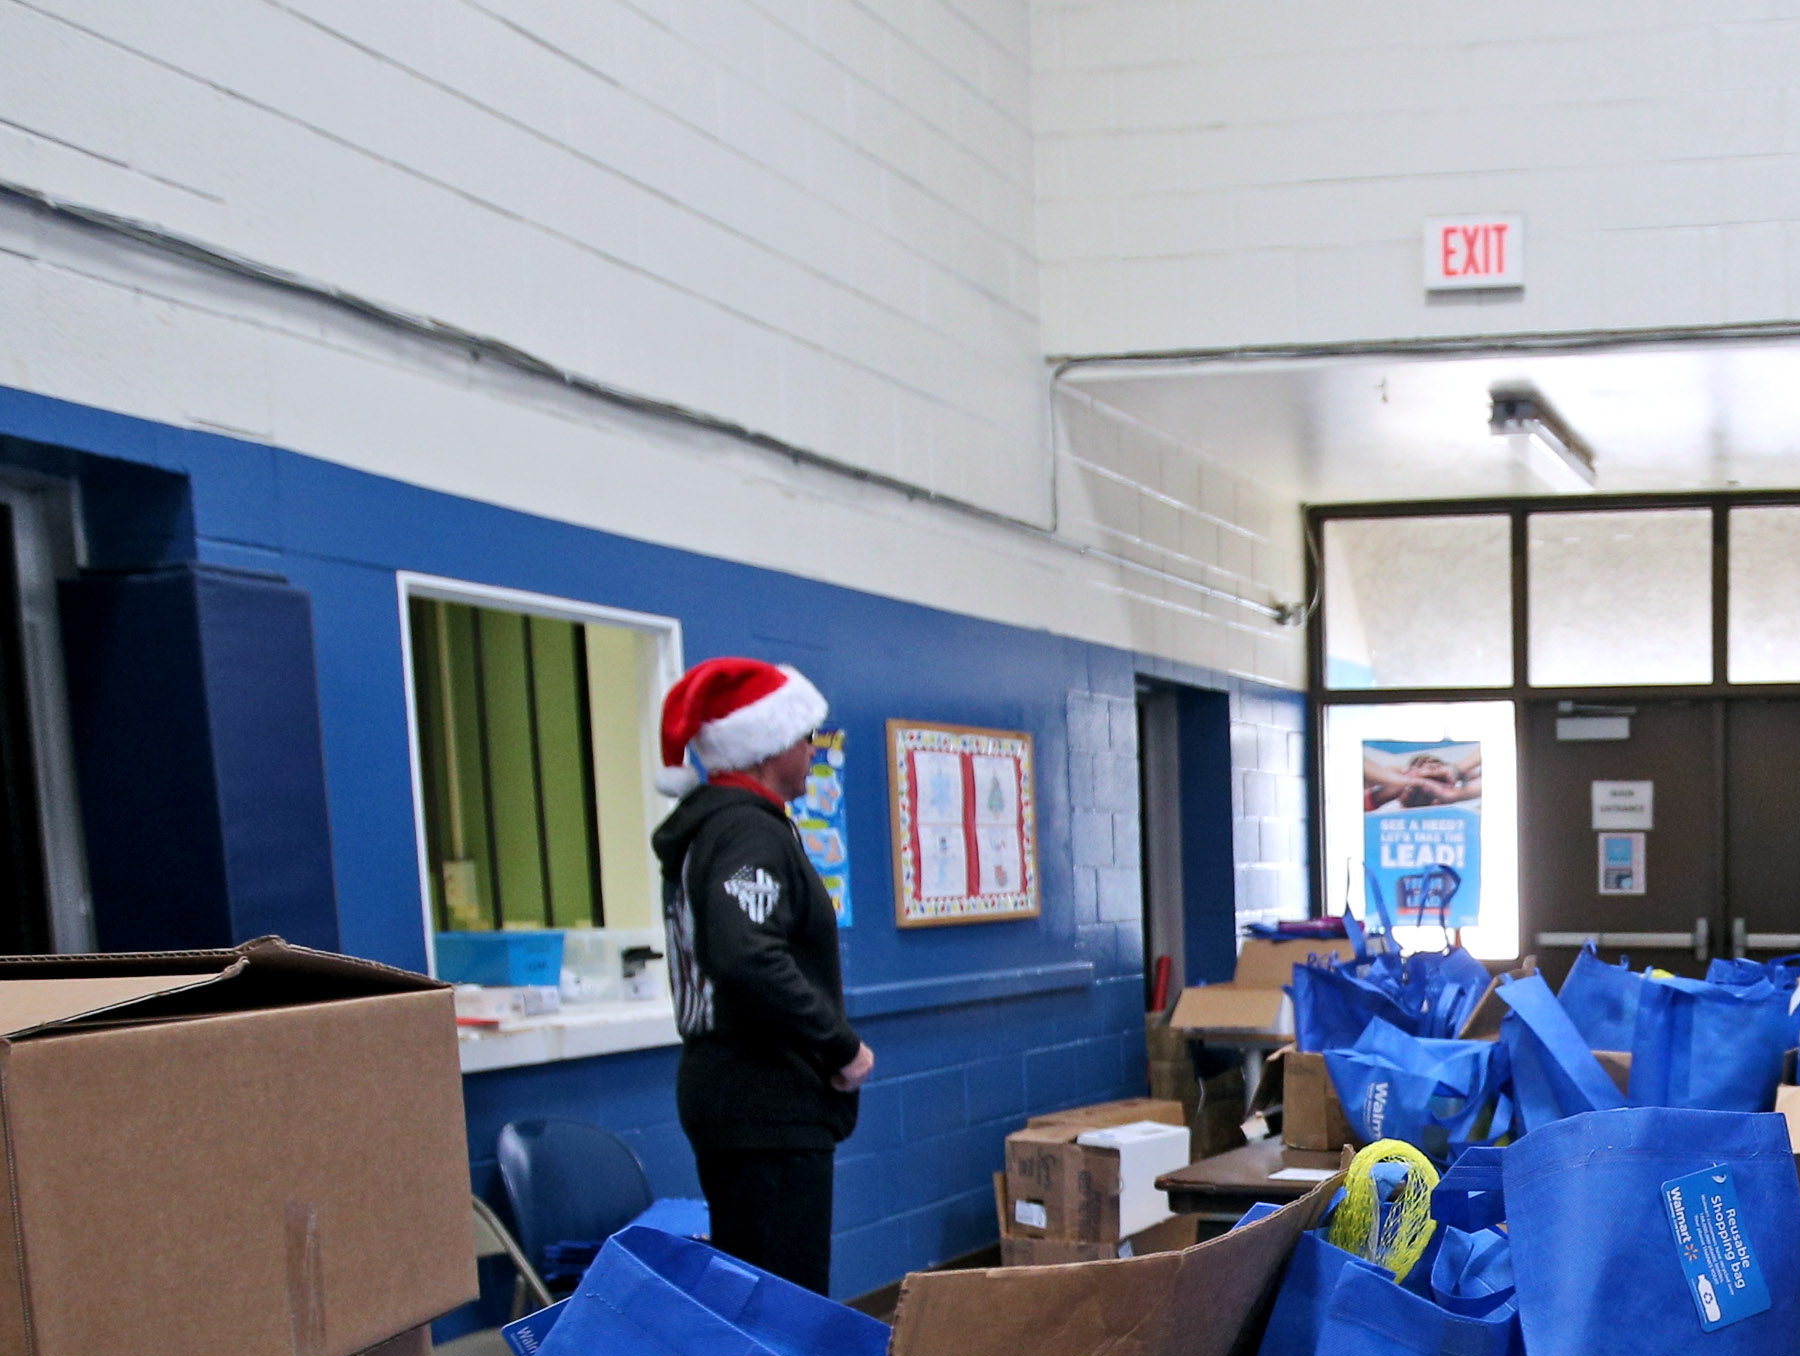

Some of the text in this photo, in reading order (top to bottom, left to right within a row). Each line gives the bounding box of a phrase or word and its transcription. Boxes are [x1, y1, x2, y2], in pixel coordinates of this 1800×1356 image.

[1442, 223, 1508, 276] EXIT
[1409, 819, 1419, 830] A
[1380, 843, 1465, 868] LEAD!
[1671, 1186, 1693, 1244] Walmart
[1711, 1195, 1745, 1289] Shopping bag
[1725, 1208, 1750, 1268] Reusable
